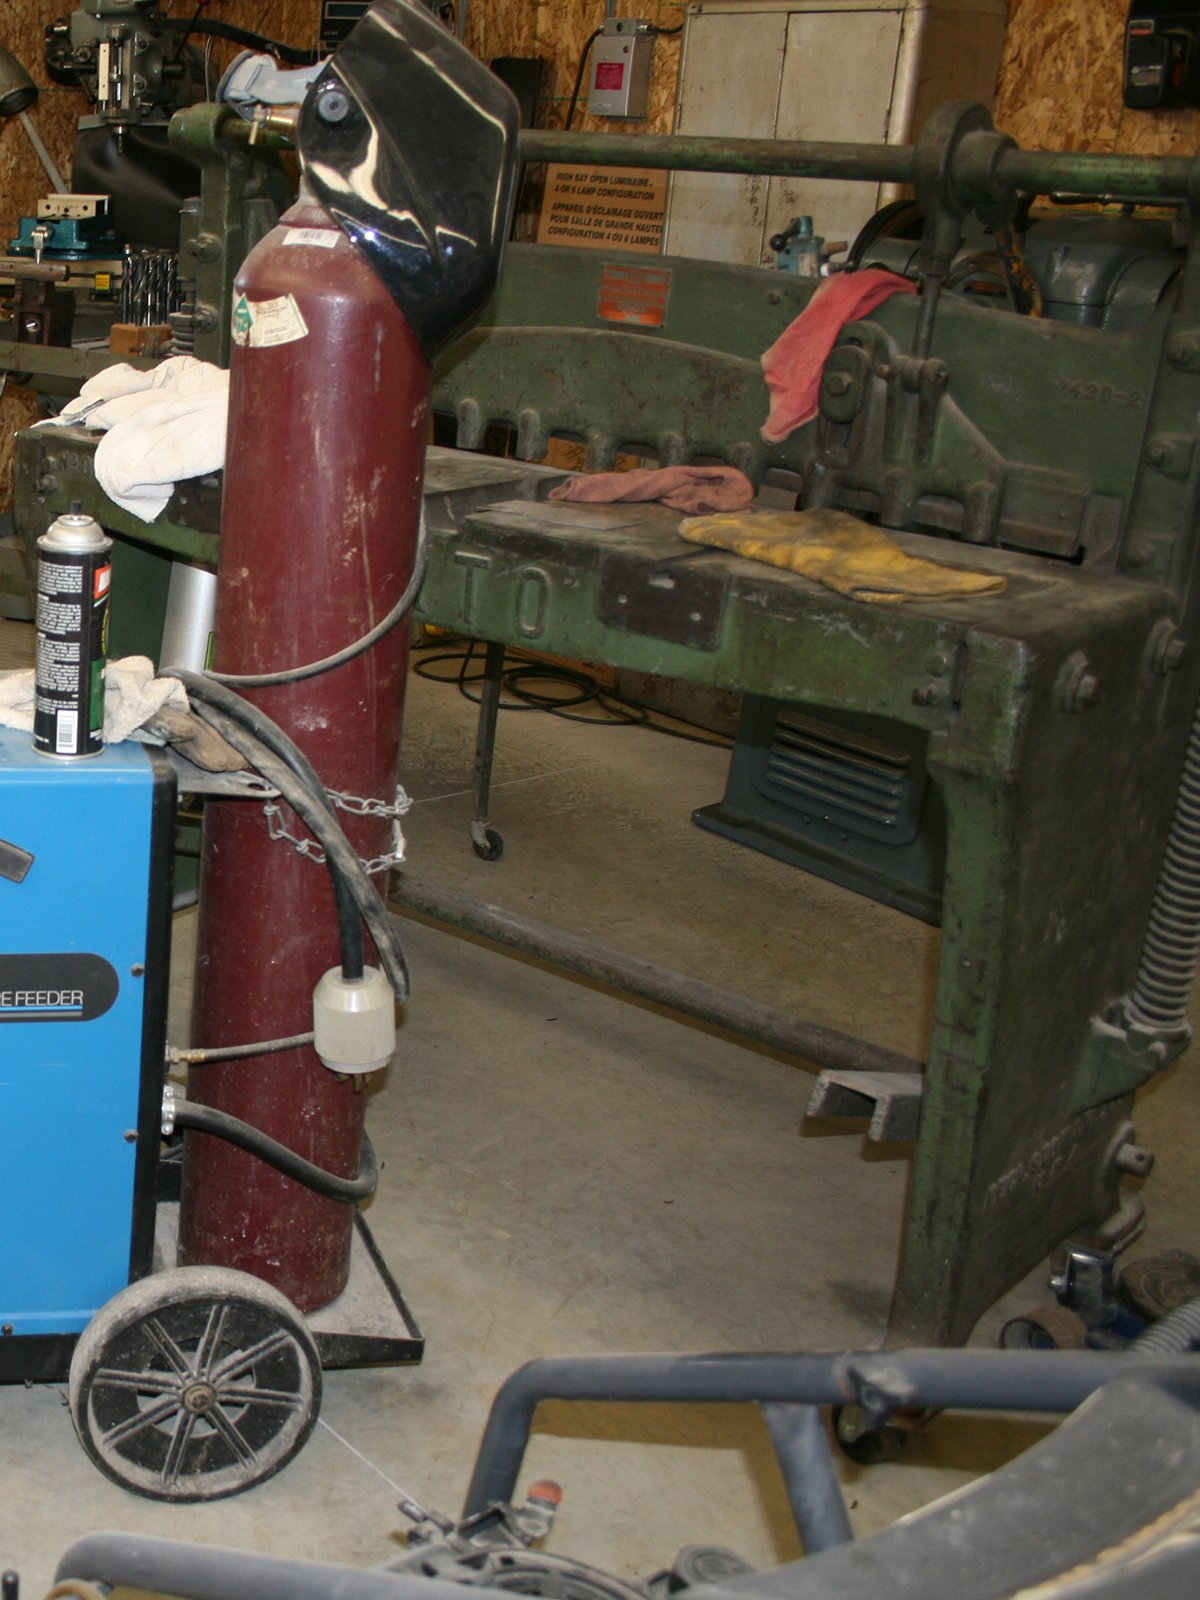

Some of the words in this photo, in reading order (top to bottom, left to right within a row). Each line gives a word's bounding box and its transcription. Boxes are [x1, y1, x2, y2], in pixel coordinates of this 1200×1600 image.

[555, 172, 573, 180] HIGH
[574, 173, 589, 182] BAY
[590, 174, 608, 184] OPEN
[609, 176, 649, 187] LUMINAIRE
[561, 185, 571, 193] OR
[576, 187, 596, 195] LAMP
[597, 188, 655, 200] CONFIGURATION
[552, 202, 584, 213] APPAREIL
[633, 210, 664, 221] OUVERT
[550, 214, 570, 223] POUR
[570, 216, 592, 226] SALLE
[593, 218, 603, 227] DE
[604, 219, 634, 231] GRANDE
[548, 226, 606, 240] CONFIGURATION
[612, 233, 624, 242] OU
[630, 235, 660, 246] LAMPES
[14, 989, 84, 1007] FEEDER
